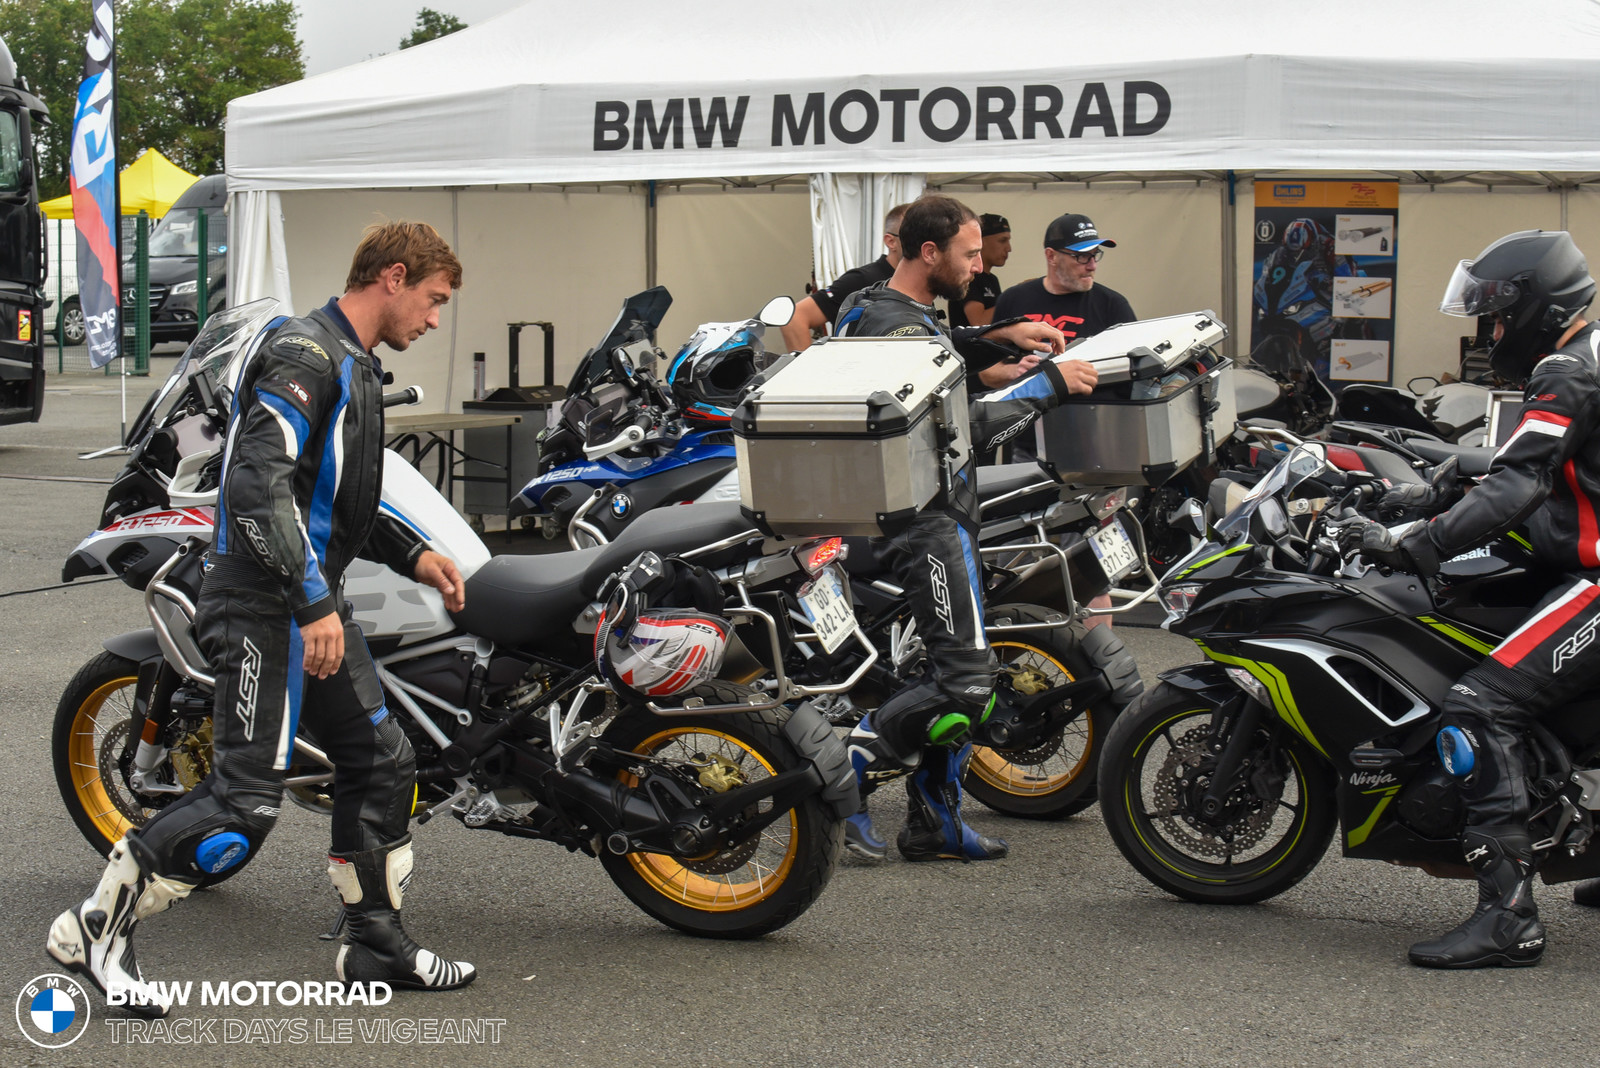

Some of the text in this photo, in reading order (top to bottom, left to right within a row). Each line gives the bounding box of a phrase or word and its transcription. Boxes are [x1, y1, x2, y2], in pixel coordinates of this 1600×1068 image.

[593, 79, 1173, 152] BMW MOTORRAD
[986, 410, 1036, 450] RST
[118, 514, 185, 532] R1250
[1439, 545, 1491, 565] asaki
[927, 553, 955, 636] RST
[235, 635, 262, 742] RST
[1450, 683, 1478, 697] ST
[1349, 769, 1398, 789] Ninja
[252, 805, 281, 817] RS
